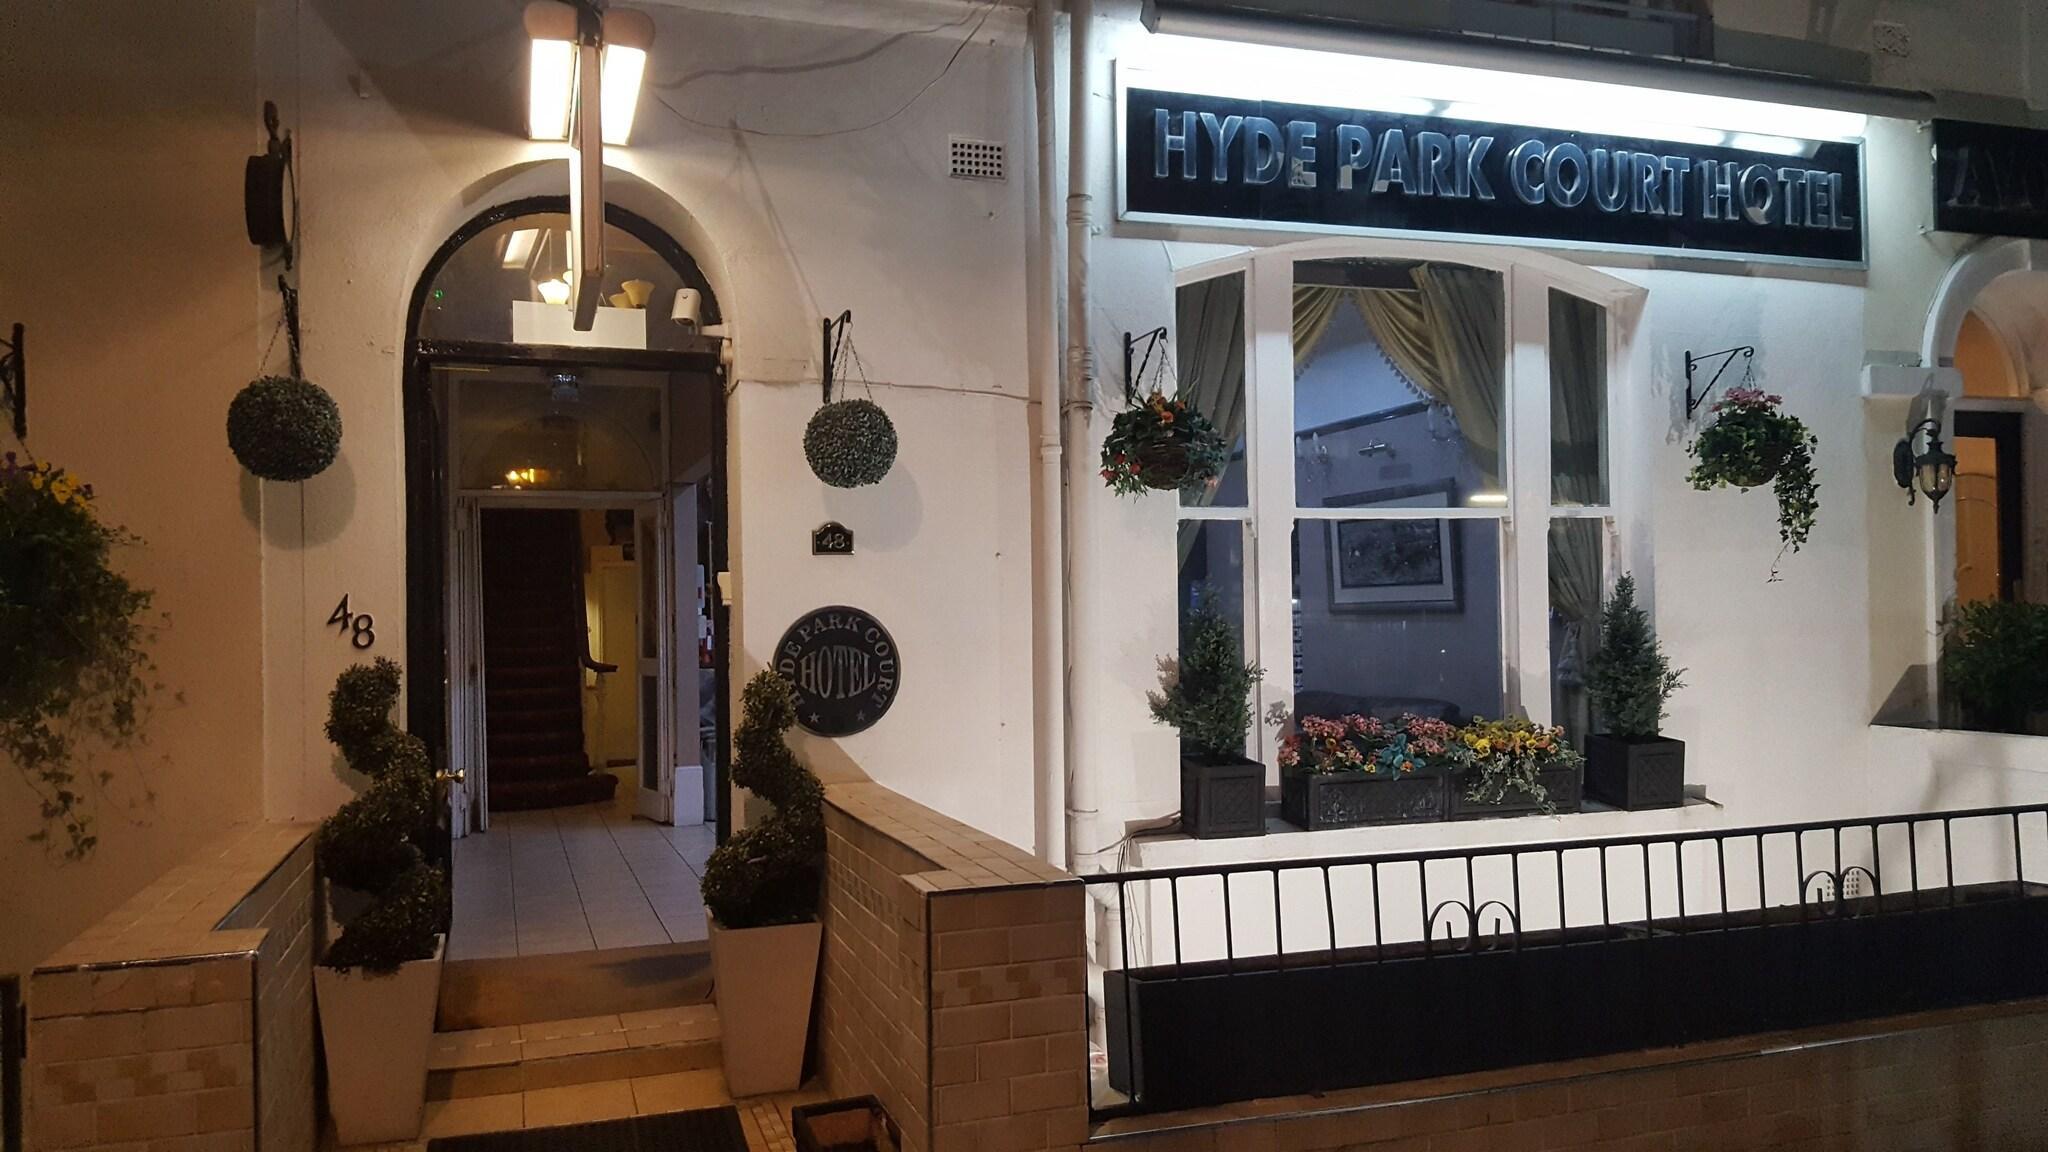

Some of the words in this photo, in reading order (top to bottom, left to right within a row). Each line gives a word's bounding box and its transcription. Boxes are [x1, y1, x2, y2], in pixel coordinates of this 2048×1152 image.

[1154, 108, 1317, 188] HYDE
[1335, 124, 1496, 200] PARK
[1509, 140, 1689, 216] COURT
[1700, 159, 1854, 230] HOTEL
[821, 532, 845, 549] 48
[327, 593, 375, 649] 48
[797, 613, 862, 642] PARK
[865, 627, 895, 708] COURT
[800, 645, 876, 699] HOTEL
